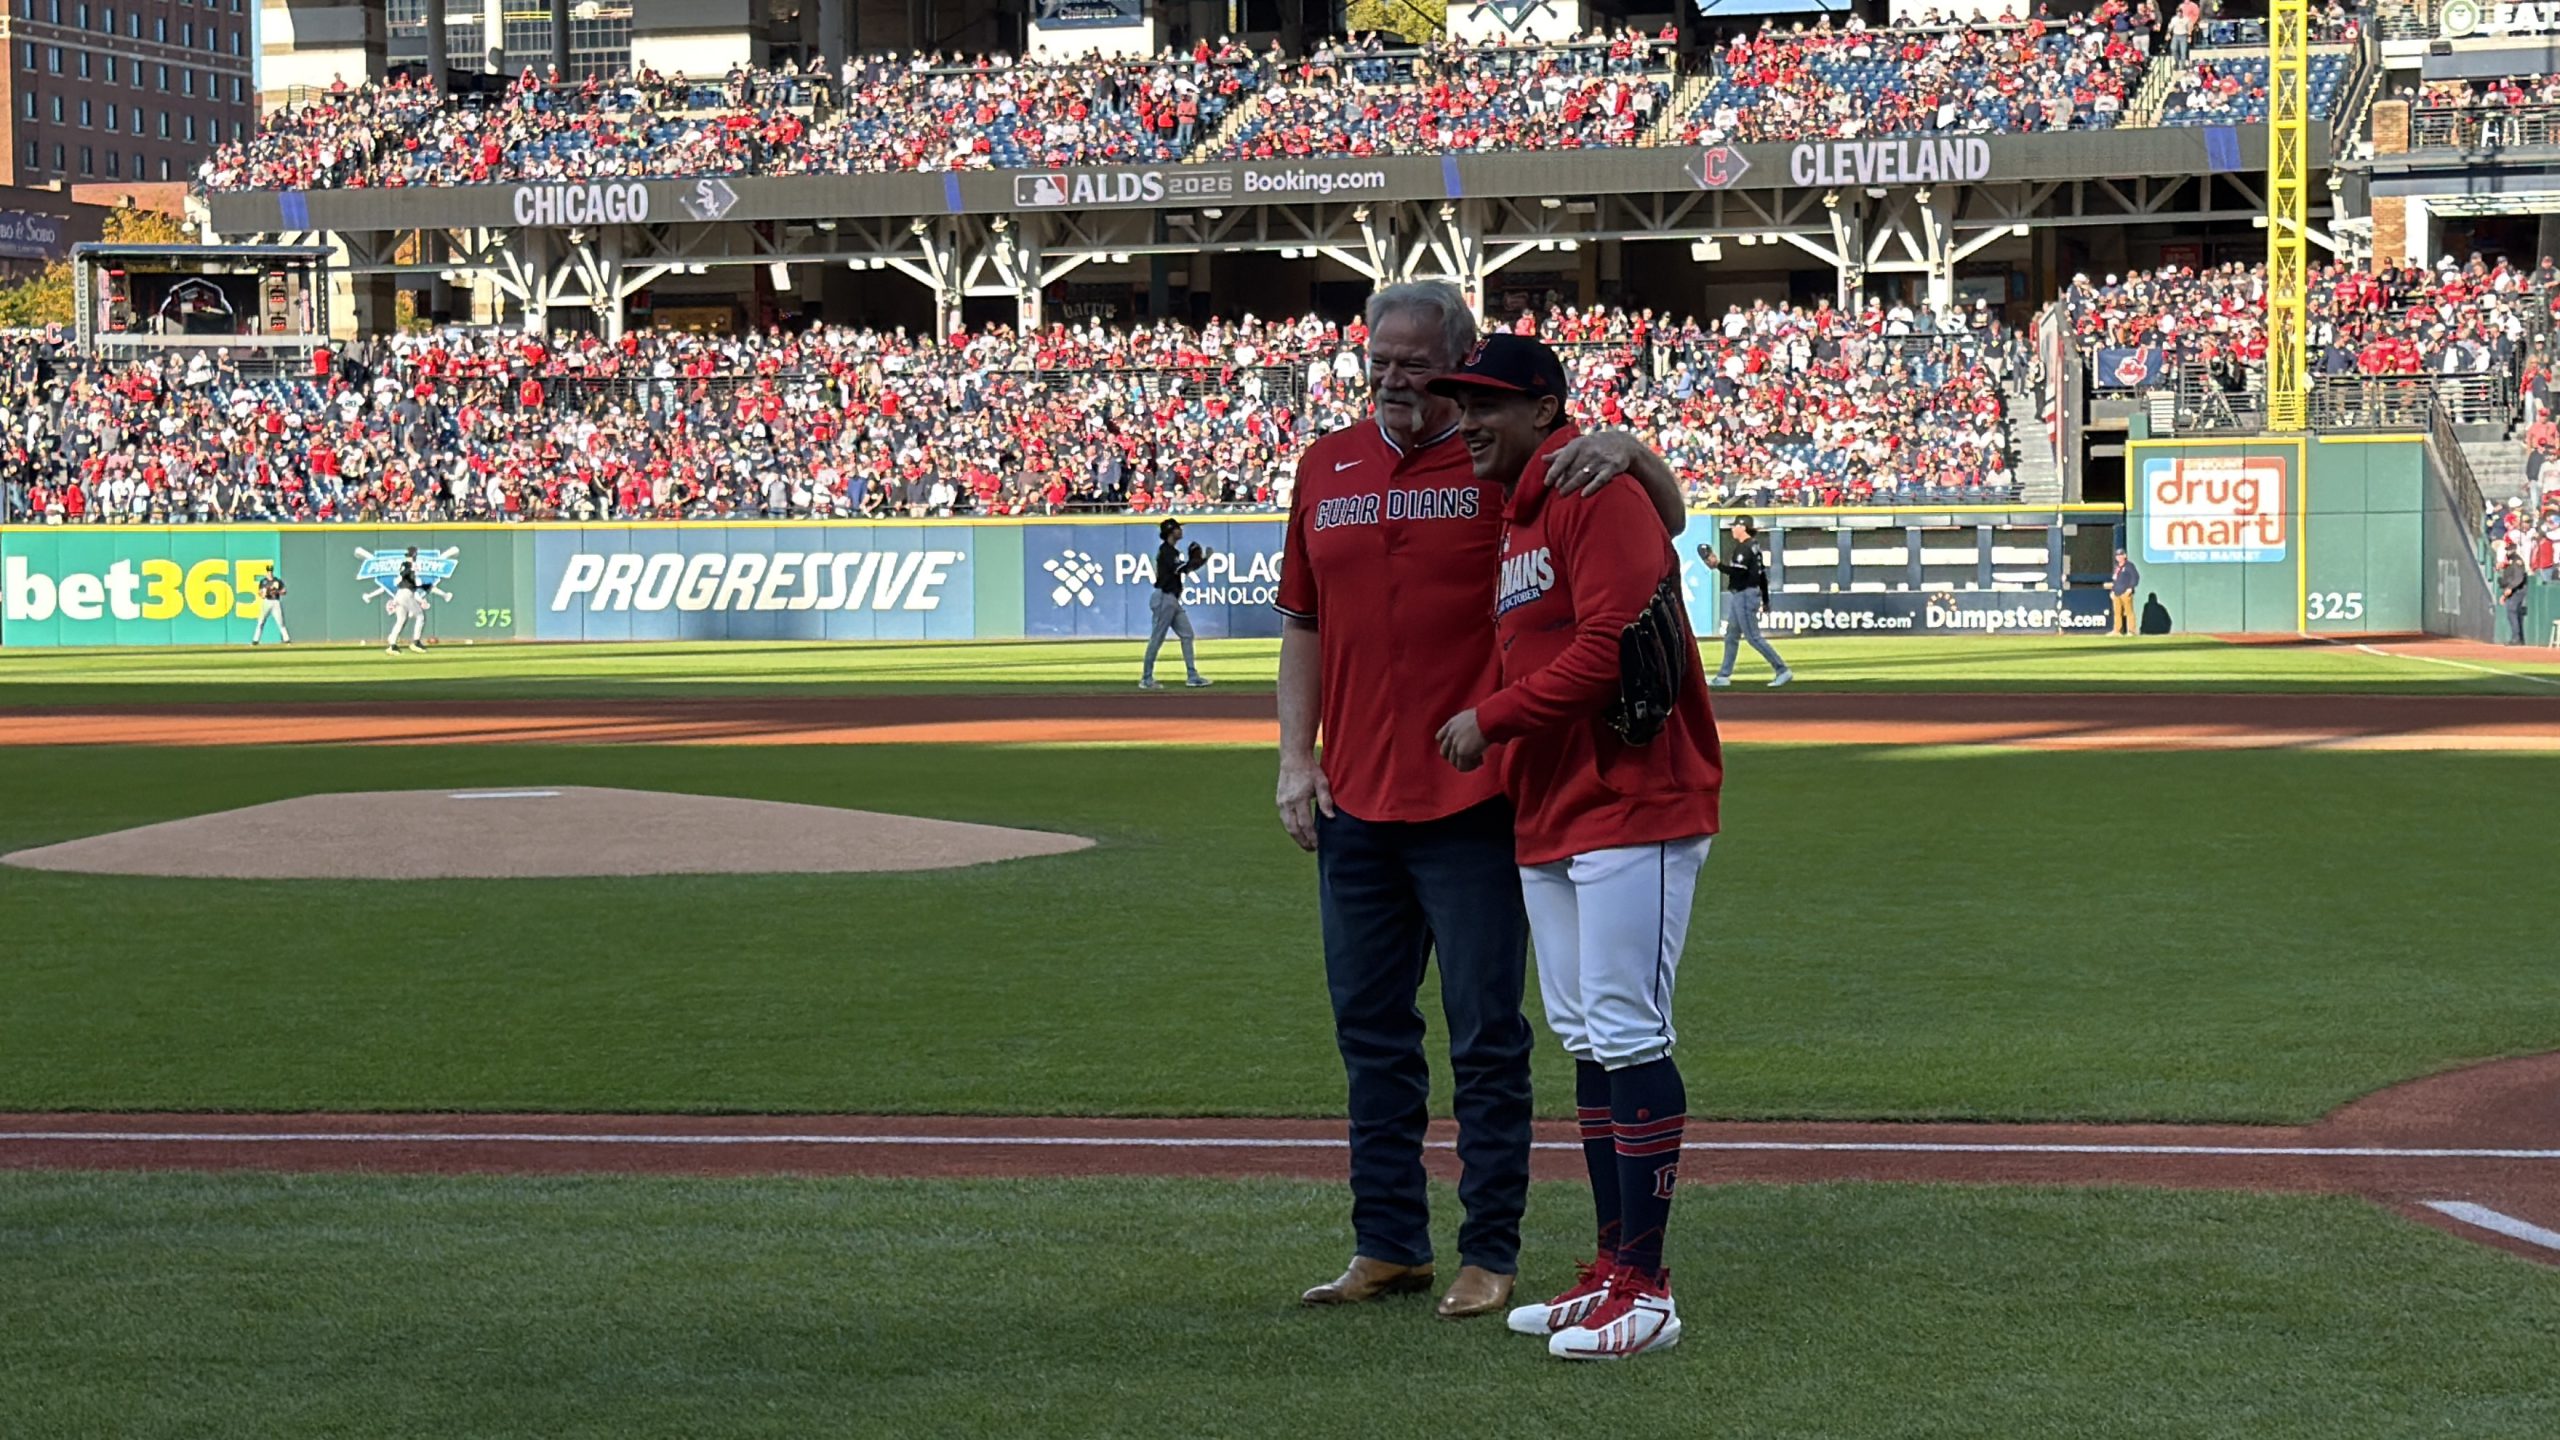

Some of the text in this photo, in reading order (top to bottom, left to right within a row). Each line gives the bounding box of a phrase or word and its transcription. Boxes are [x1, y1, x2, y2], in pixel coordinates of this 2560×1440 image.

[1059, 6, 1117, 20] Children's
[1791, 138, 1990, 186] CLEVELAND
[1071, 172, 1232, 203] ALDS 2026
[1244, 169, 1384, 194] Booking.com
[514, 182, 648, 226] CHICAGO
[2157, 459, 2259, 516] drug
[2167, 513, 2285, 546] mart
[551, 551, 958, 612] PROGRESSIVE
[1115, 552, 1284, 585] PAK PLAC
[5, 555, 274, 621] bet365
[475, 609, 511, 627] 375
[1756, 608, 1911, 634] umpsters.com
[1926, 605, 2106, 634] Dumpsters.com
[2307, 592, 2364, 620] 325
